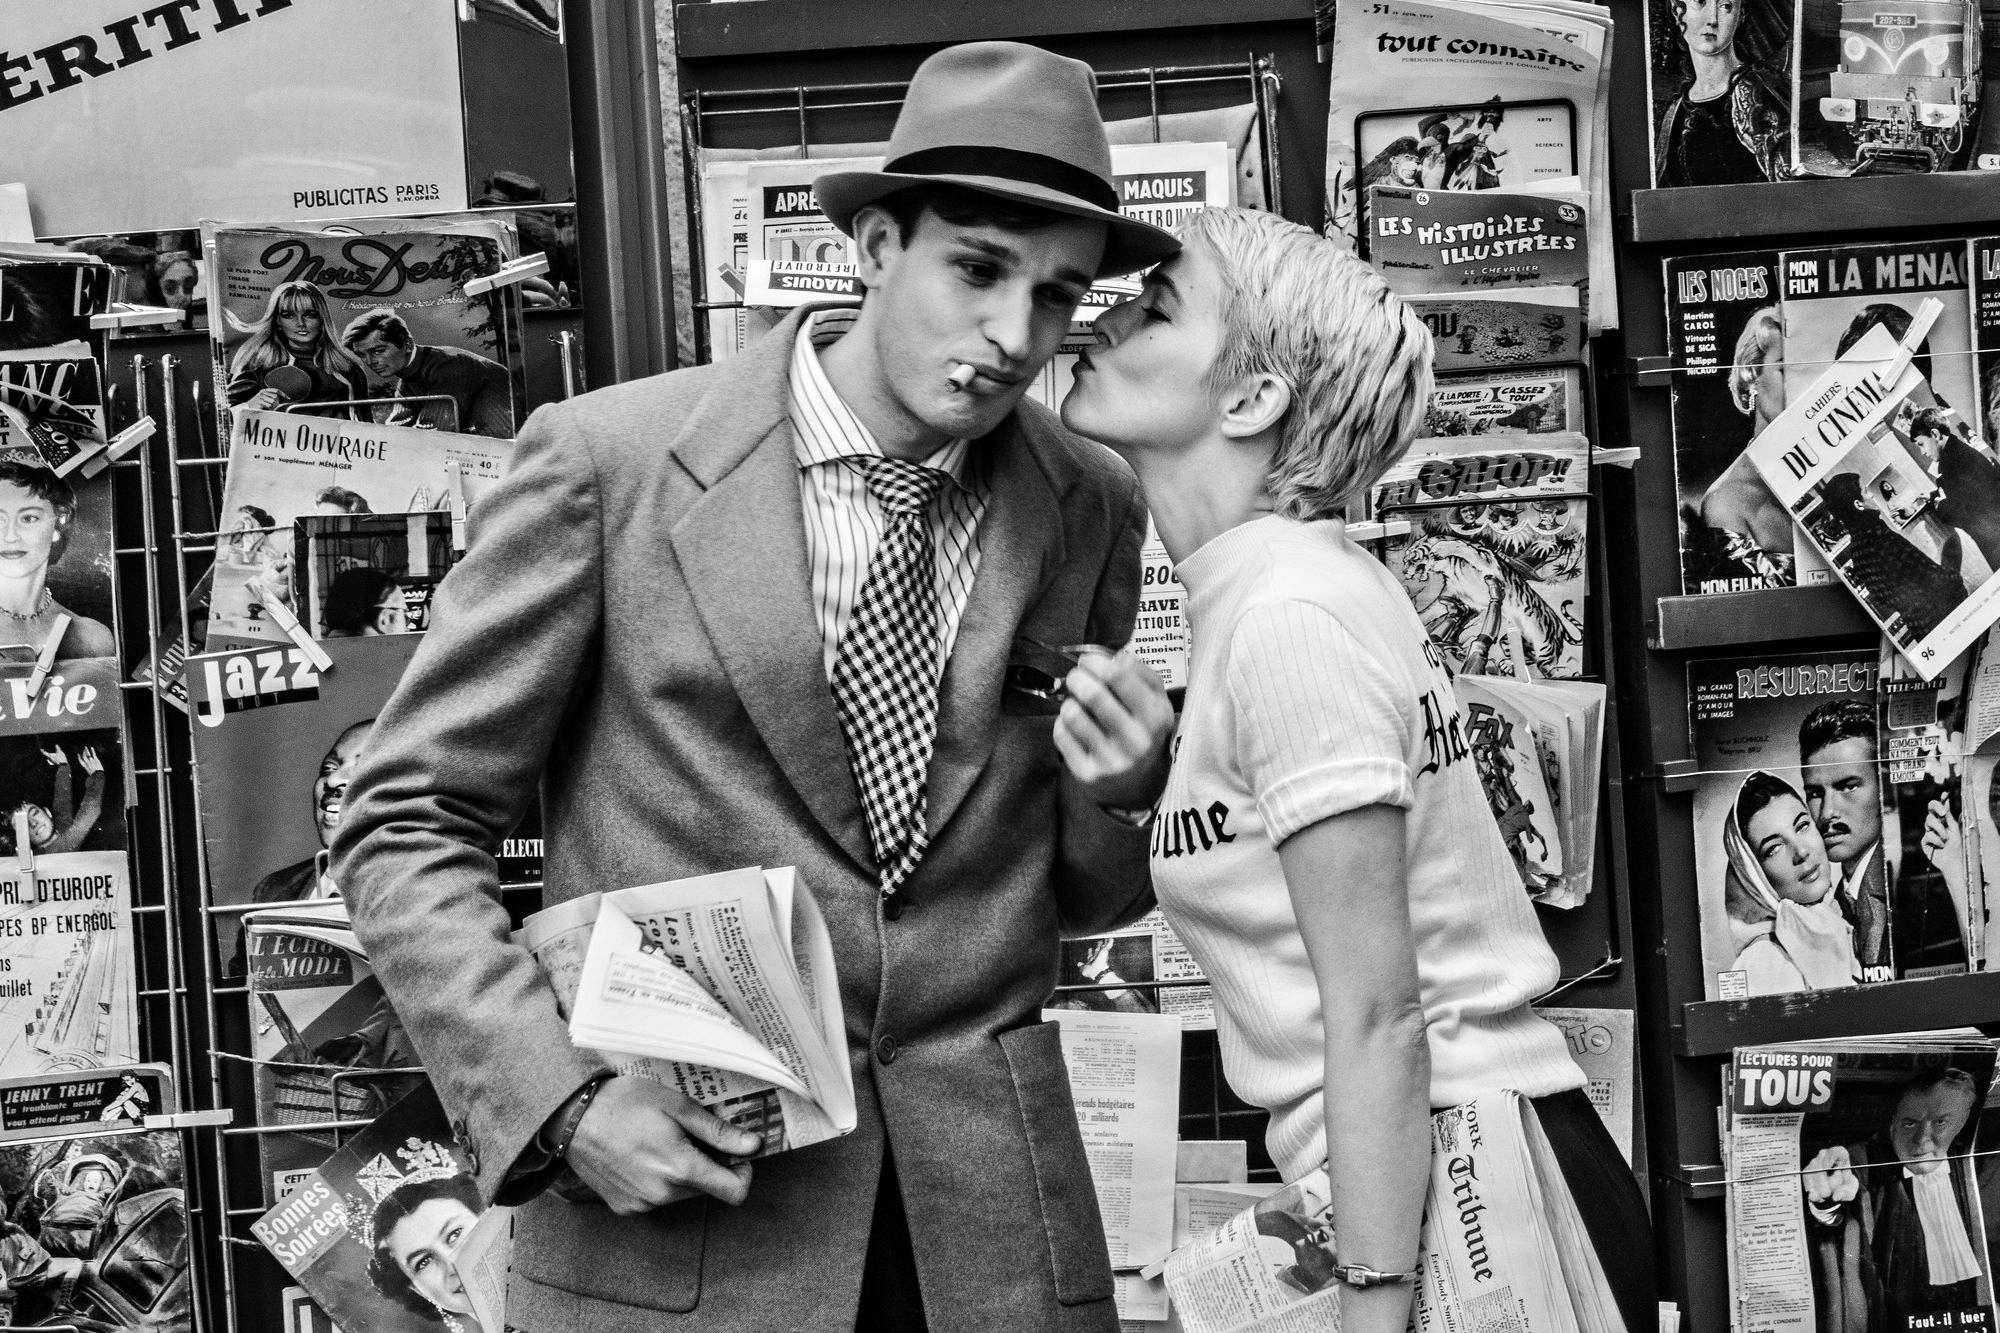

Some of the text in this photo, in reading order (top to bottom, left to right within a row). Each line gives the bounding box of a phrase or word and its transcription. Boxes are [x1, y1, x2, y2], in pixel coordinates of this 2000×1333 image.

[1373, 3, 1389, 14] 51
[1376, 32, 1585, 72] tout connaître
[293, 184, 440, 208] PUBLICITAS PARIS
[1123, 177, 1194, 201] MAQUIS
[774, 191, 823, 213] APRE
[1378, 216, 1413, 237] LES
[260, 239, 377, 286] Nous
[1481, 265, 1539, 275] CHEVALIER
[227, 275, 250, 283] TIRAGE
[1789, 260, 1818, 278] MON
[1828, 257, 1863, 292] LA
[782, 276, 854, 292] MAQUIS
[1677, 265, 1769, 304] LES NOCES
[1789, 278, 1819, 295] FILM
[1683, 311, 1715, 321] Martine
[1684, 321, 1716, 331] CAROL
[1685, 333, 1716, 344] Vittorio
[1685, 343, 1717, 353] DE SICA
[1447, 390, 1482, 400] LA PORTE
[1501, 386, 1547, 394] CASSEZ
[1509, 394, 1536, 402] TOUT
[1804, 381, 1842, 420] CAHIERS
[296, 424, 388, 462] OUVRAGE
[279, 456, 316, 467] supplément
[319, 459, 352, 471] MÉNAGER
[480, 460, 492, 470] 40
[1781, 434, 1820, 481] DU
[1700, 576, 1762, 595] MON FILM
[1135, 633, 1184, 643] nouvelles
[1134, 644, 1184, 654] chinoises
[1711, 683, 1734, 691] GRAND
[4, 675, 98, 719] Vie
[1697, 701, 1734, 710] D'AMOUR
[1710, 710, 1734, 719] IMAGES
[1890, 737, 1923, 749] COMMENT
[37, 874, 114, 903] D'EUROPE
[32, 911, 117, 935] BP ENERGOL
[664, 916, 680, 946] Les
[277, 957, 346, 978] MODE
[1740, 1053, 1834, 1067] LECTURES POUR
[4, 1081, 106, 1104] JENNY TRENT
[692, 1079, 706, 1100] chez
[1739, 1068, 1832, 1107] TOUS
[6, 1102, 68, 1115] La troublante
[1098, 1097, 1135, 1110] budgétaires
[6, 1110, 90, 1127] vous attend page 7
[1091, 1111, 1119, 1122] milliards
[1465, 1099, 1483, 1151] YORK
[254, 1181, 330, 1247] Bonnes
[1447, 1153, 1494, 1284] Tribune
[274, 1202, 348, 1266] Soirées
[1430, 1253, 1449, 1303] Everybody
[1518, 1298, 1526, 1315] Price
[1960, 1311, 1986, 1324] tuer
